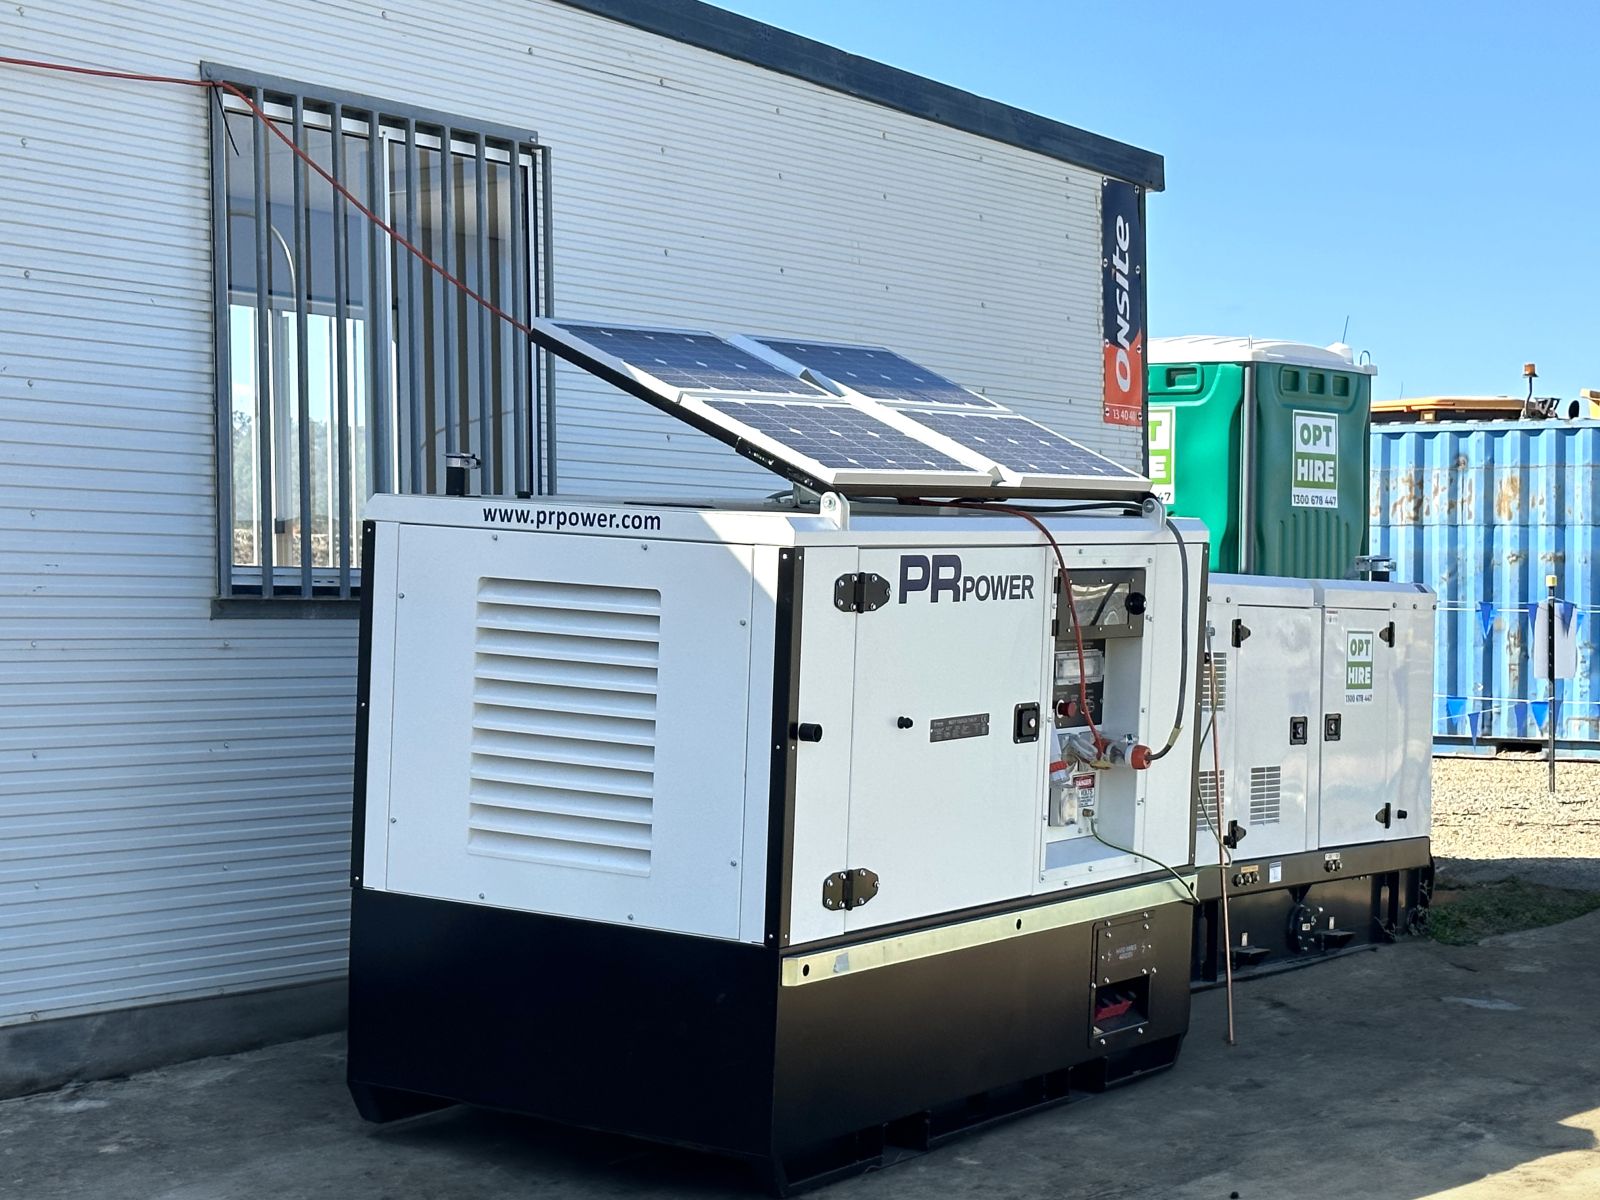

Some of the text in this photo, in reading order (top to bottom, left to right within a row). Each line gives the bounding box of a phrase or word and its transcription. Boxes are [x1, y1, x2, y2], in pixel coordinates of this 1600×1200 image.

[1300, 423, 1333, 447] OPT
[1297, 458, 1335, 484] HIRE
[1293, 494, 1337, 506] 1300 678 447
[482, 507, 661, 531] www.prpower.com
[1350, 639, 1370, 656] OPT
[1348, 666, 1371, 684] HIRE
